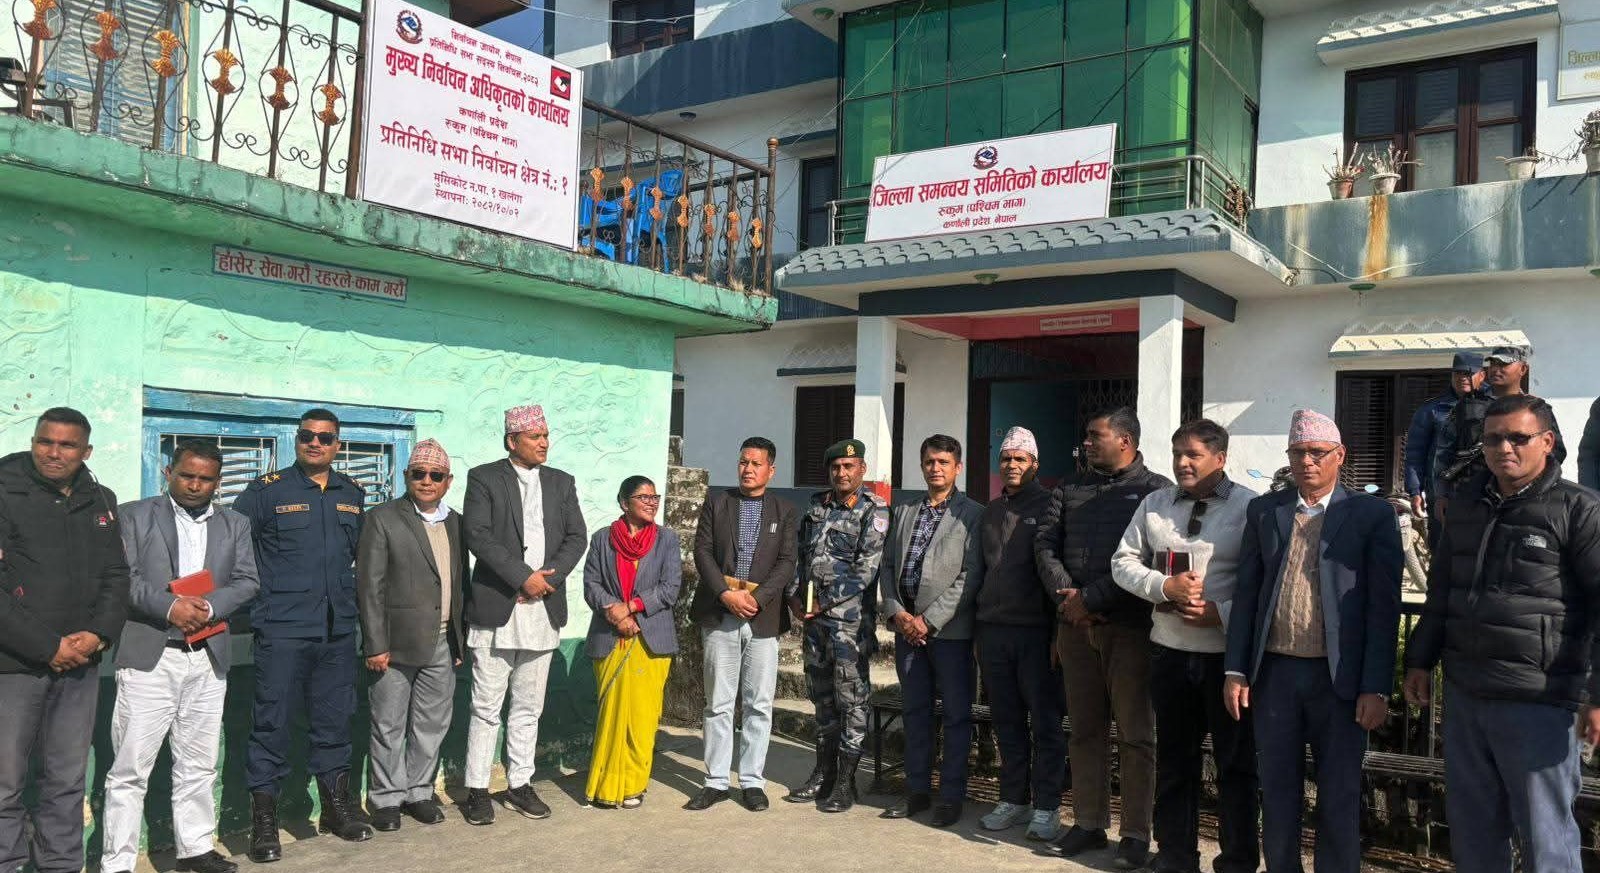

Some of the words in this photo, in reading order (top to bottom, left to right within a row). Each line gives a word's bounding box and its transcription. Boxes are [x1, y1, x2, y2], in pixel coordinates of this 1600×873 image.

[429, 37, 457, 56] प्रतिनिधि
[460, 49, 474, 61] सभा
[476, 55, 495, 68] सदस्य
[451, 28, 477, 47] निर्वाचन
[505, 48, 523, 65] नेपाल
[386, 45, 419, 76] मुख्य
[423, 52, 467, 93] निर्वाचन
[470, 73, 525, 113] अधिकृतको
[528, 95, 570, 127] कार्यालय
[445, 118, 467, 134] रुकुम
[459, 106, 486, 123] कर्णाली
[489, 116, 508, 130] प्रदेश
[380, 121, 438, 156] प्रतिनिधि
[441, 140, 469, 165] सभा
[472, 145, 518, 179] निर्वाचन
[521, 159, 540, 186] क्षेत्र
[562, 176, 568, 196] १
[434, 170, 468, 188] मुसिकोट
[498, 189, 523, 205] खलंगा
[872, 183, 914, 207] जिल्ला
[918, 178, 970, 203] समन्वय
[974, 165, 1037, 196] समितिको
[1041, 160, 1110, 187] कार्यालय
[938, 204, 963, 217] रुकुम
[943, 217, 970, 228] कर्णाली
[994, 213, 1017, 225] नेपाल
